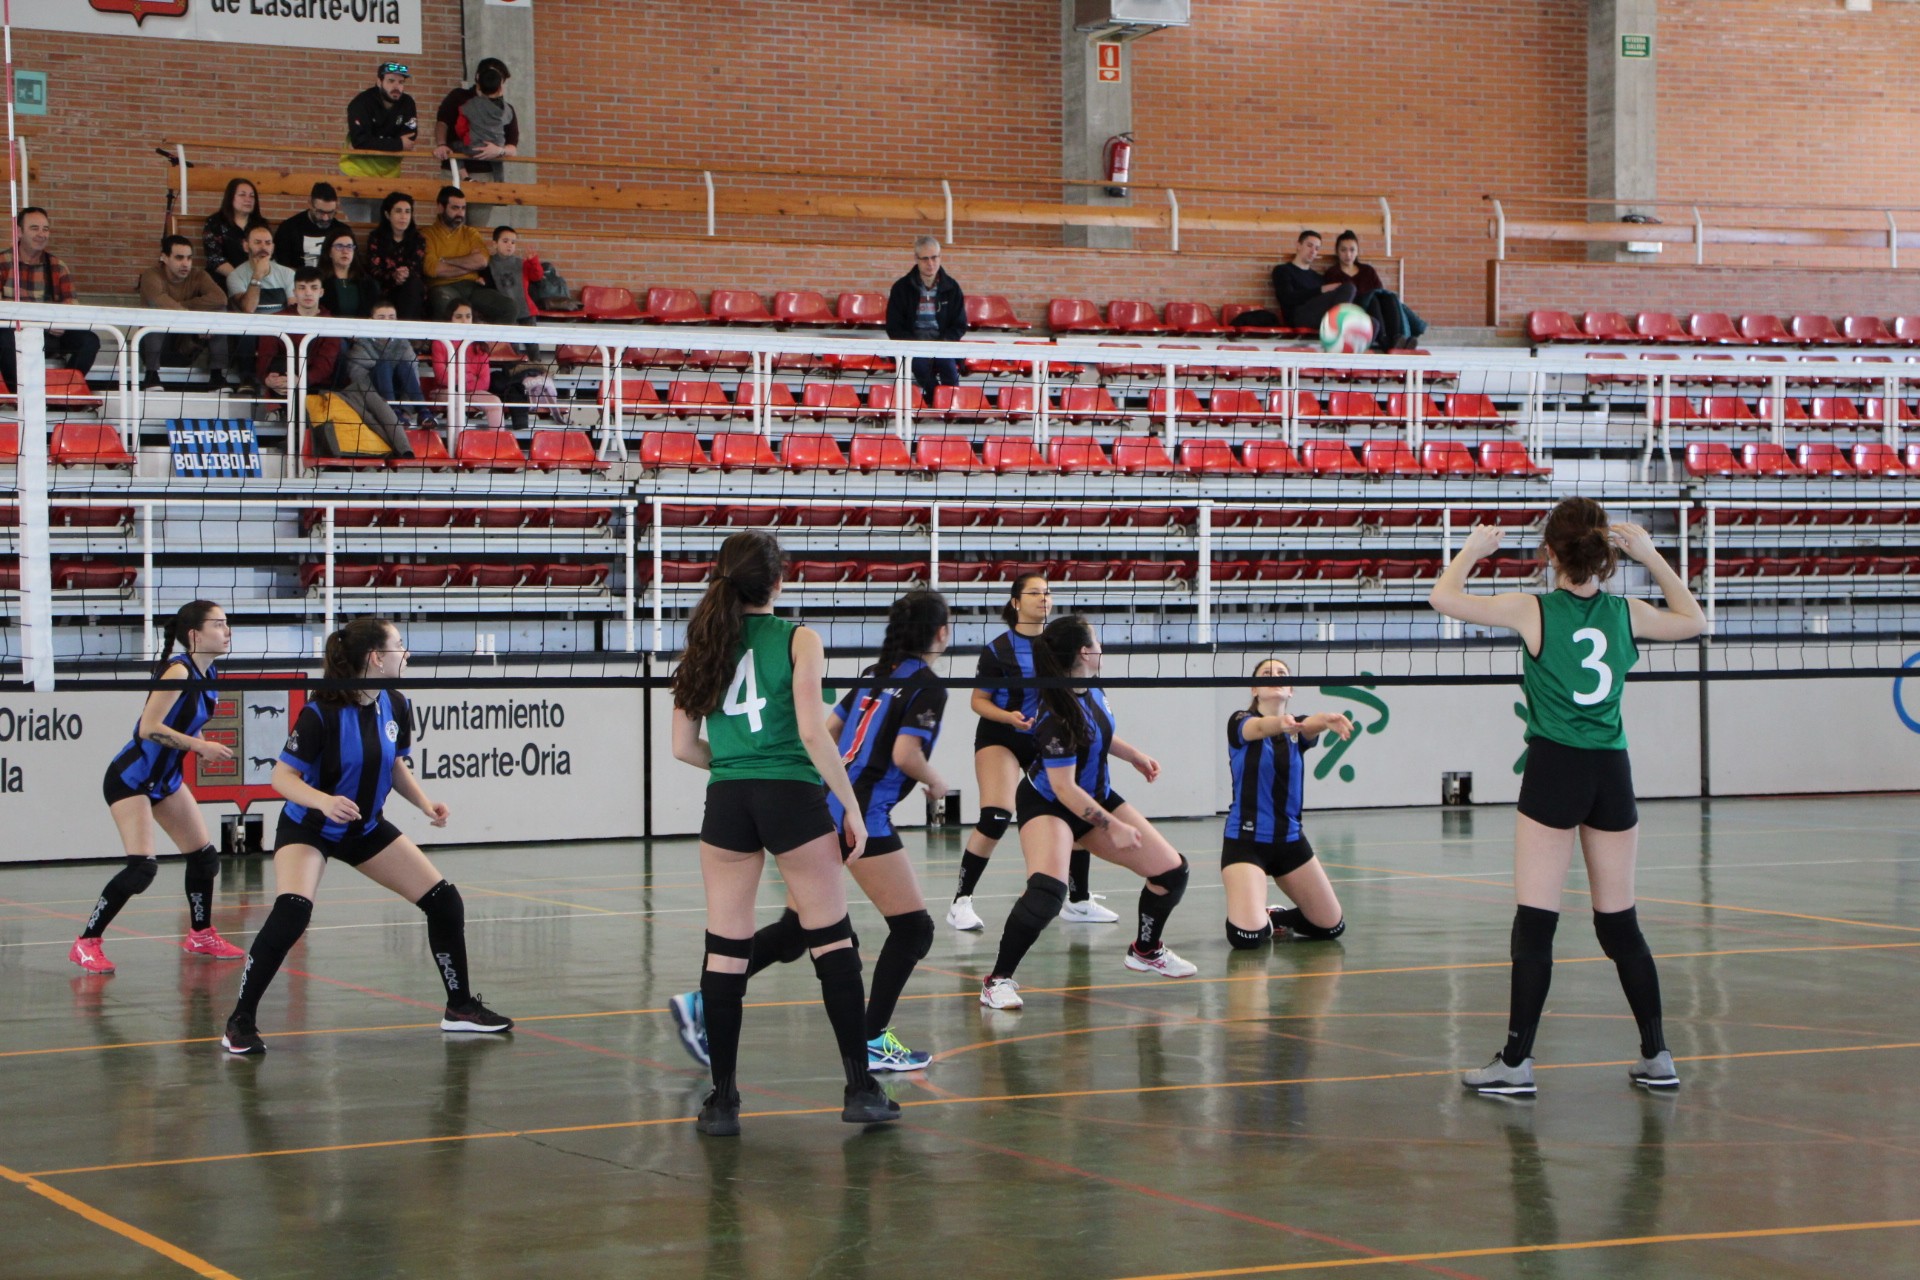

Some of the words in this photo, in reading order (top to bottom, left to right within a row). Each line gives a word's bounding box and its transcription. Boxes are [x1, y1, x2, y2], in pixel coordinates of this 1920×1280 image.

[174, 453, 260, 470] BOLEIBOLA
[722, 648, 767, 733] 4
[1572, 627, 1613, 705] 3
[422, 742, 572, 780] Lasarte-Oria
